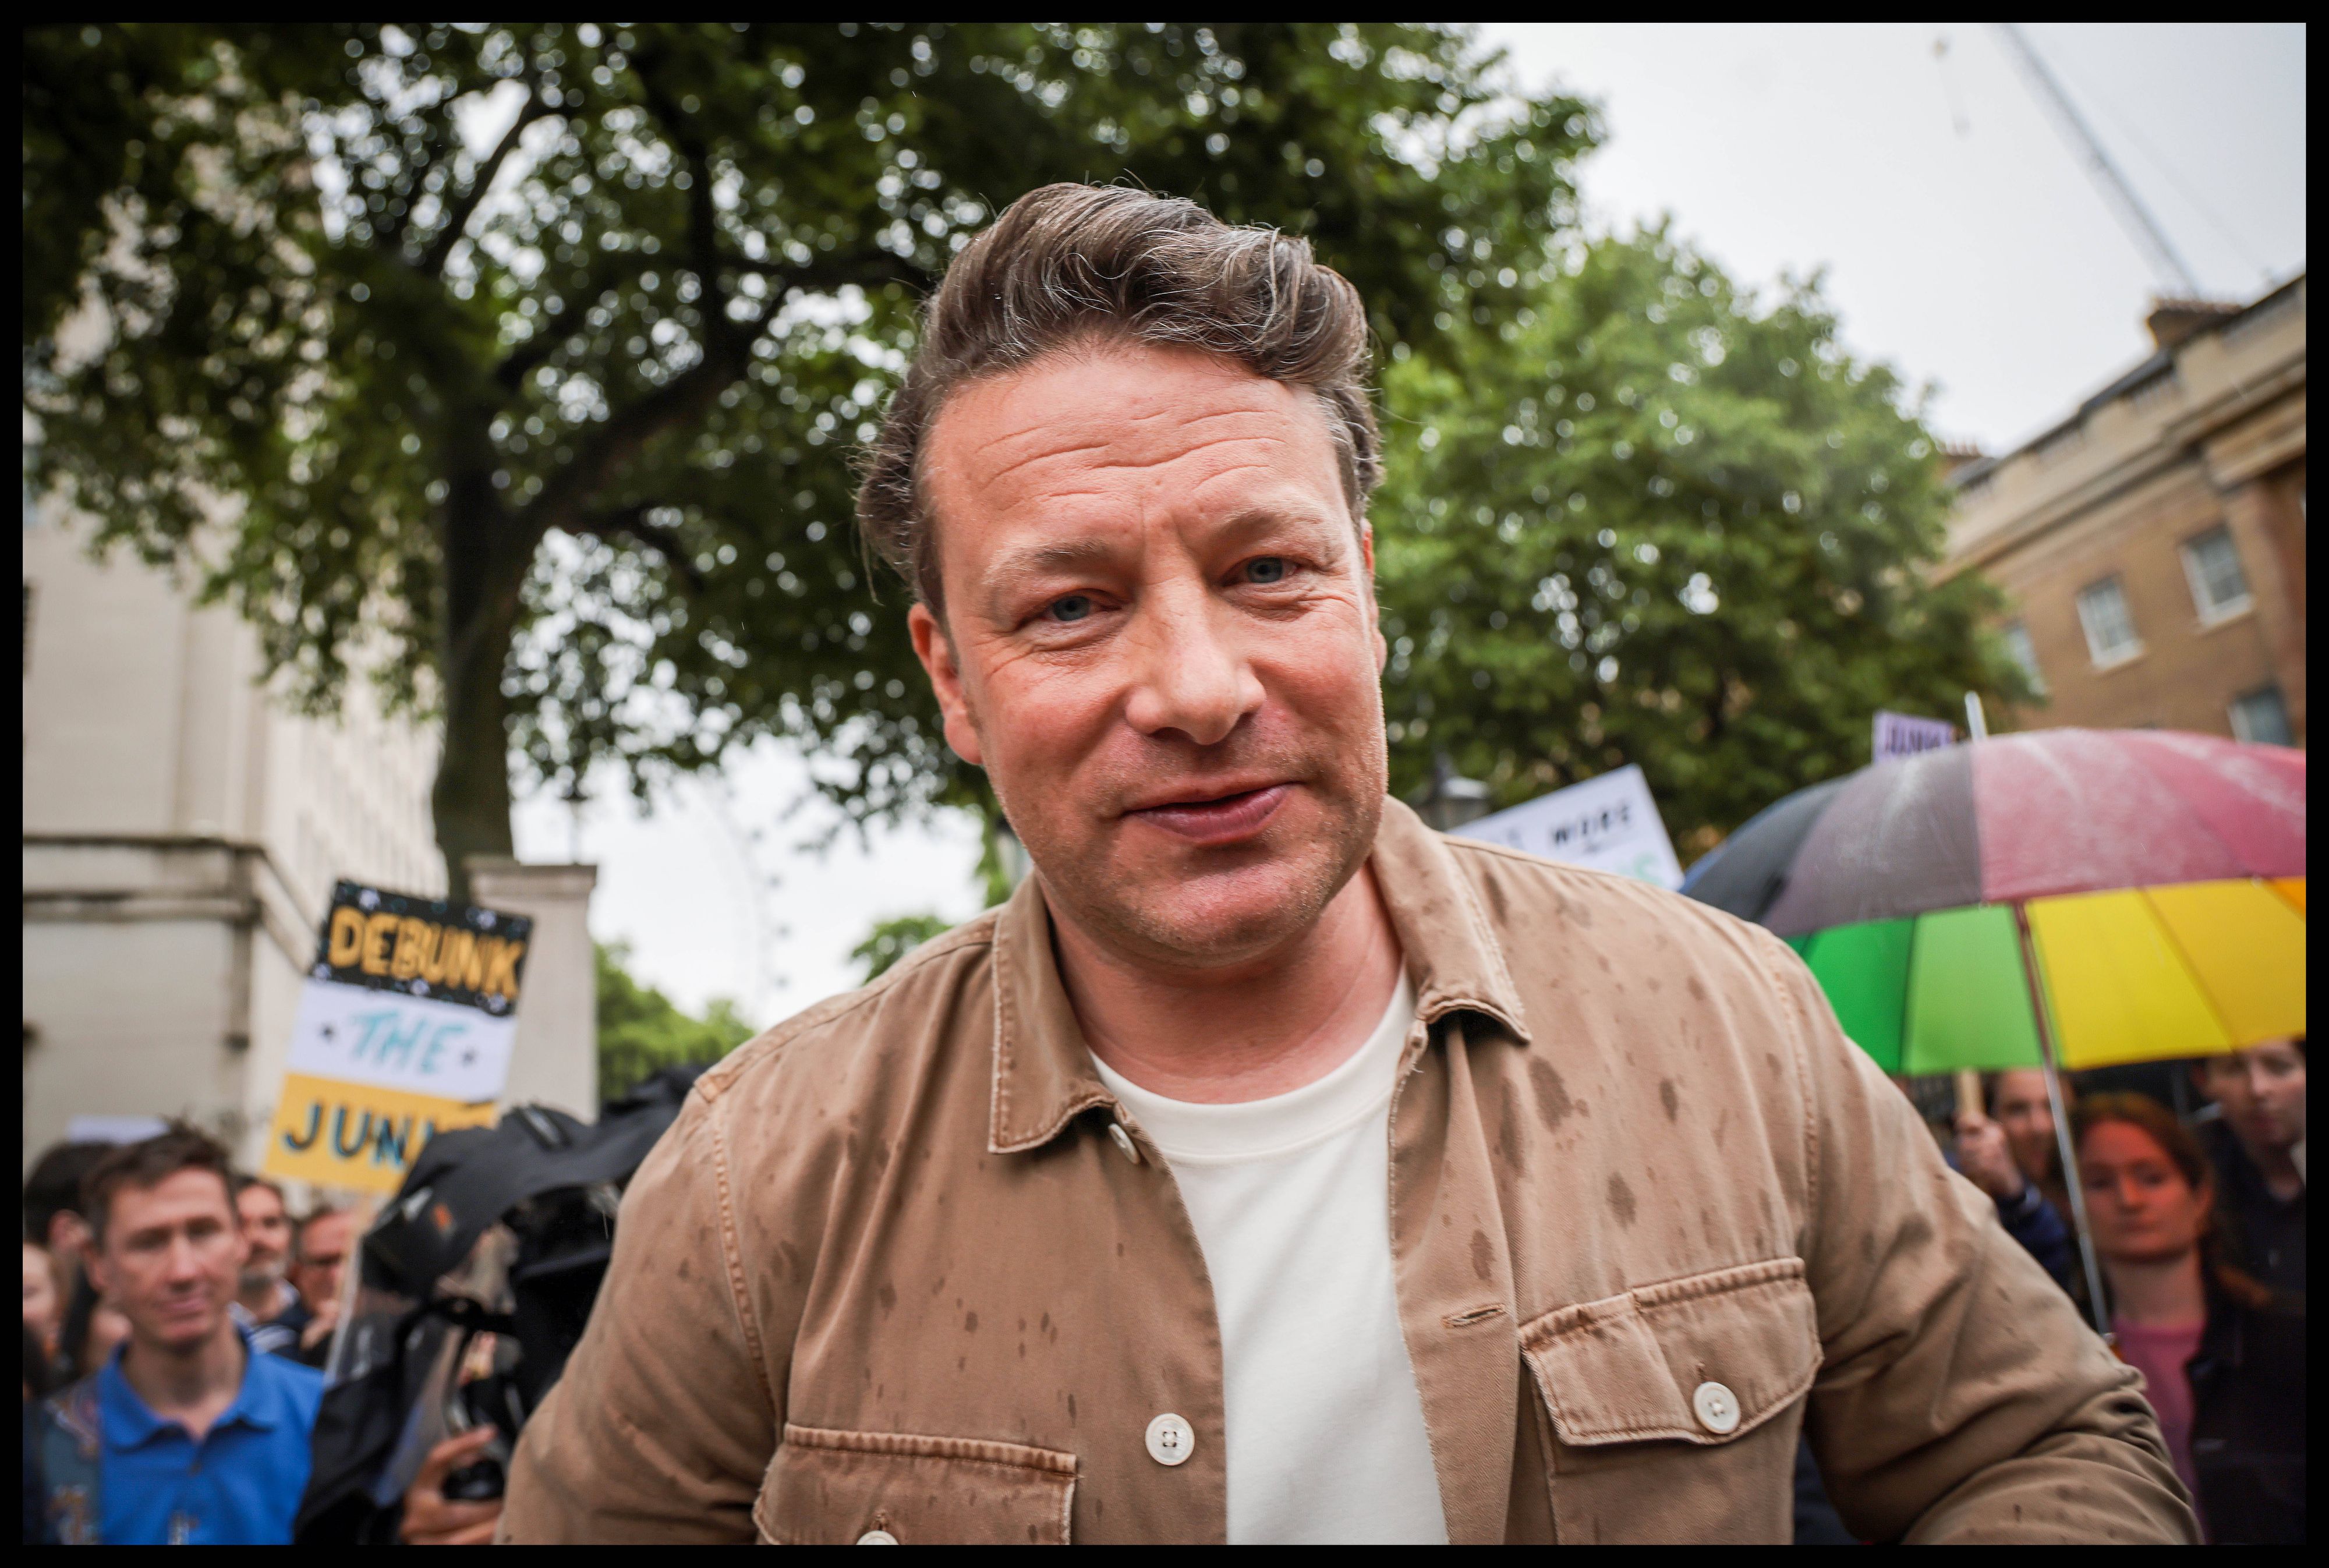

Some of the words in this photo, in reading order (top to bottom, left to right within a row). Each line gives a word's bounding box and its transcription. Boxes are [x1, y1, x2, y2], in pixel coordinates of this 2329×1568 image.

[327, 905, 525, 1000] DEBUNK
[353, 1009, 469, 1074] THE
[282, 1099, 434, 1170] JUN
